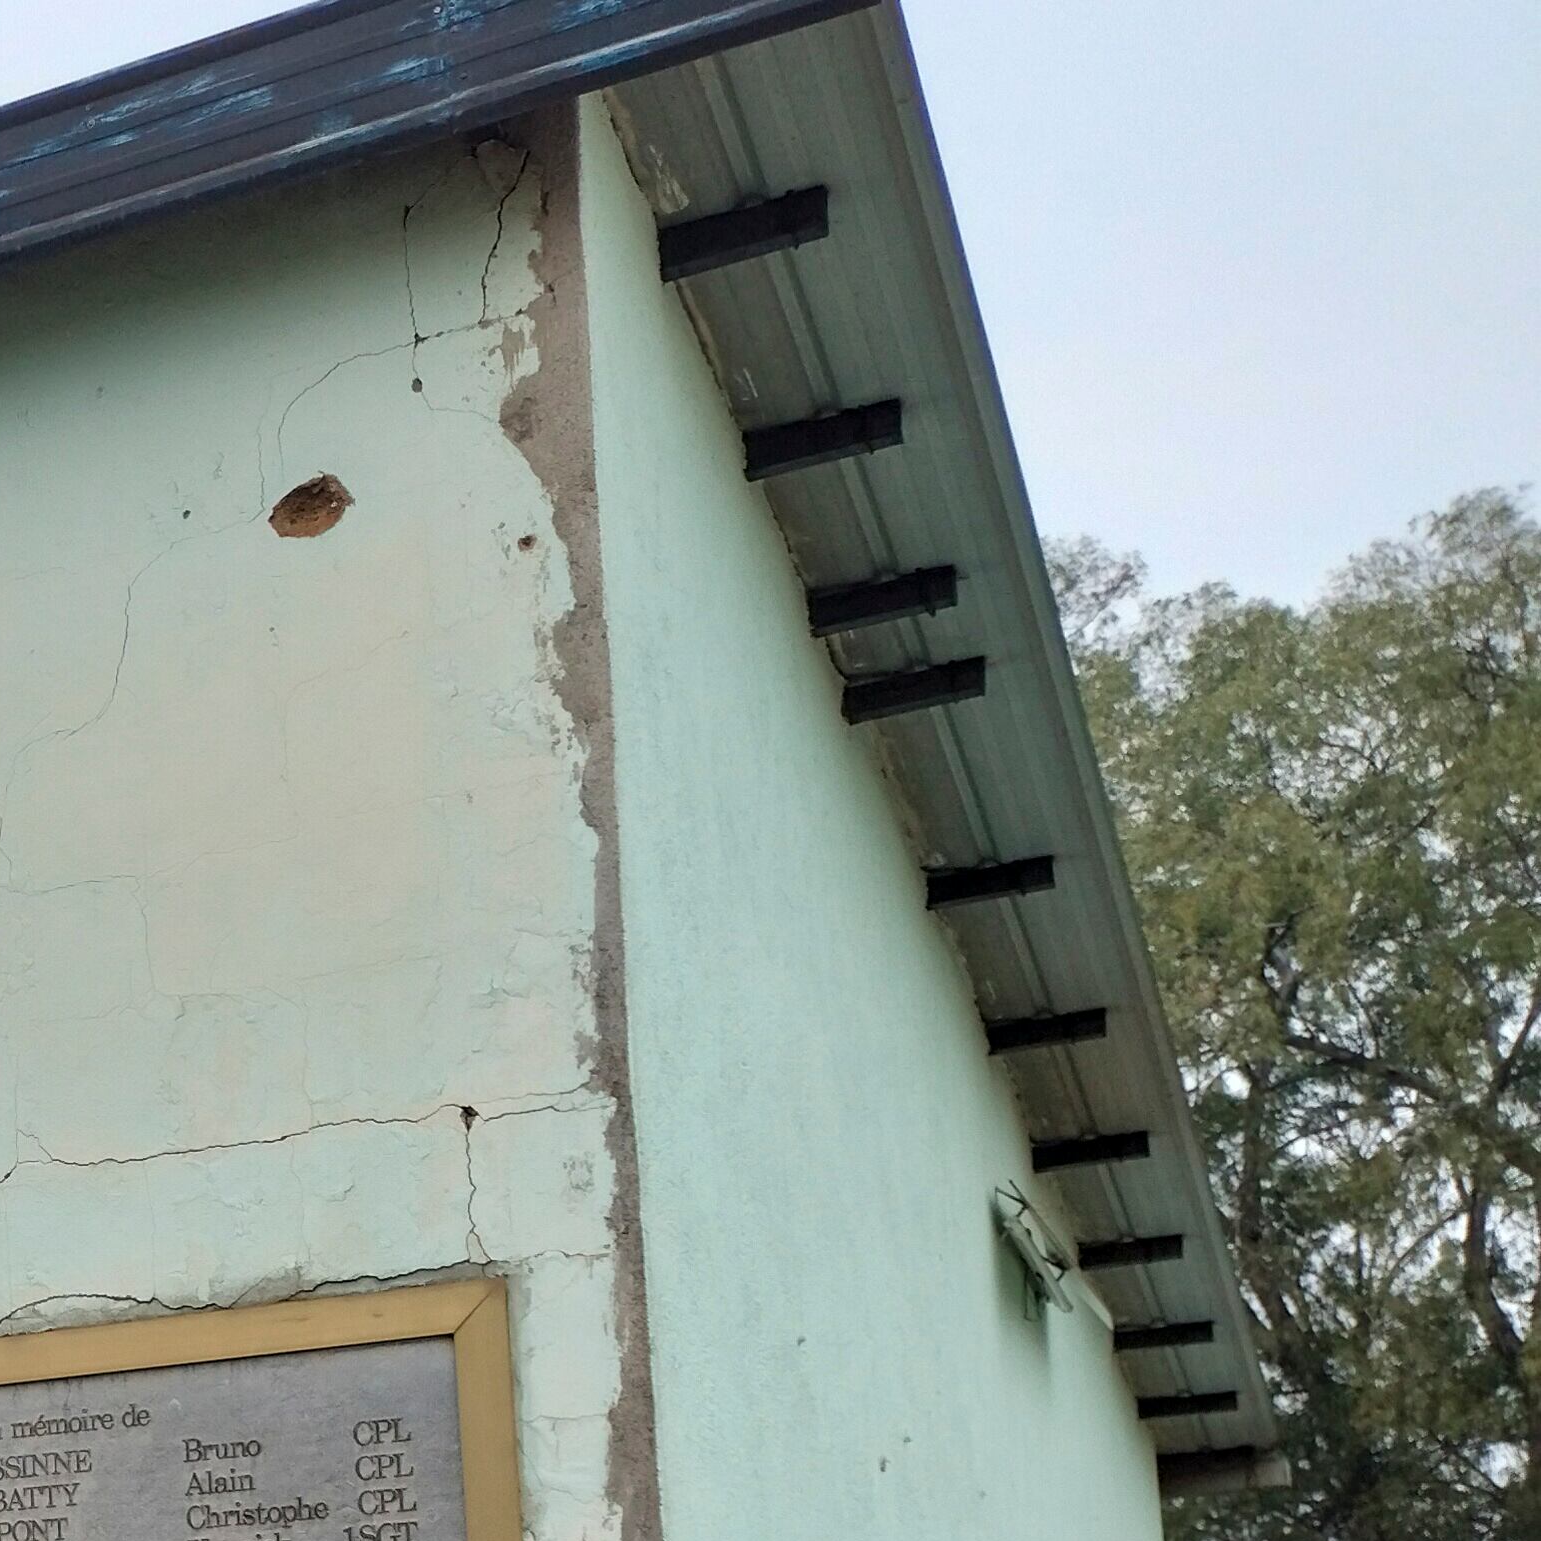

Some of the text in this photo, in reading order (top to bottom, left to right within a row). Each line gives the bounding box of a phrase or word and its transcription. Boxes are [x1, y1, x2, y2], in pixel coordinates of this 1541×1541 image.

[11, 1409, 114, 1439] mémoire
[122, 1404, 151, 1428] de
[182, 1439, 261, 1463] Bruno
[353, 1418, 412, 1446] CPL
[185, 1469, 256, 1496] Alain
[355, 1453, 414, 1481] CPL
[187, 1497, 330, 1530] Christophe
[358, 1488, 417, 1515] CPL
